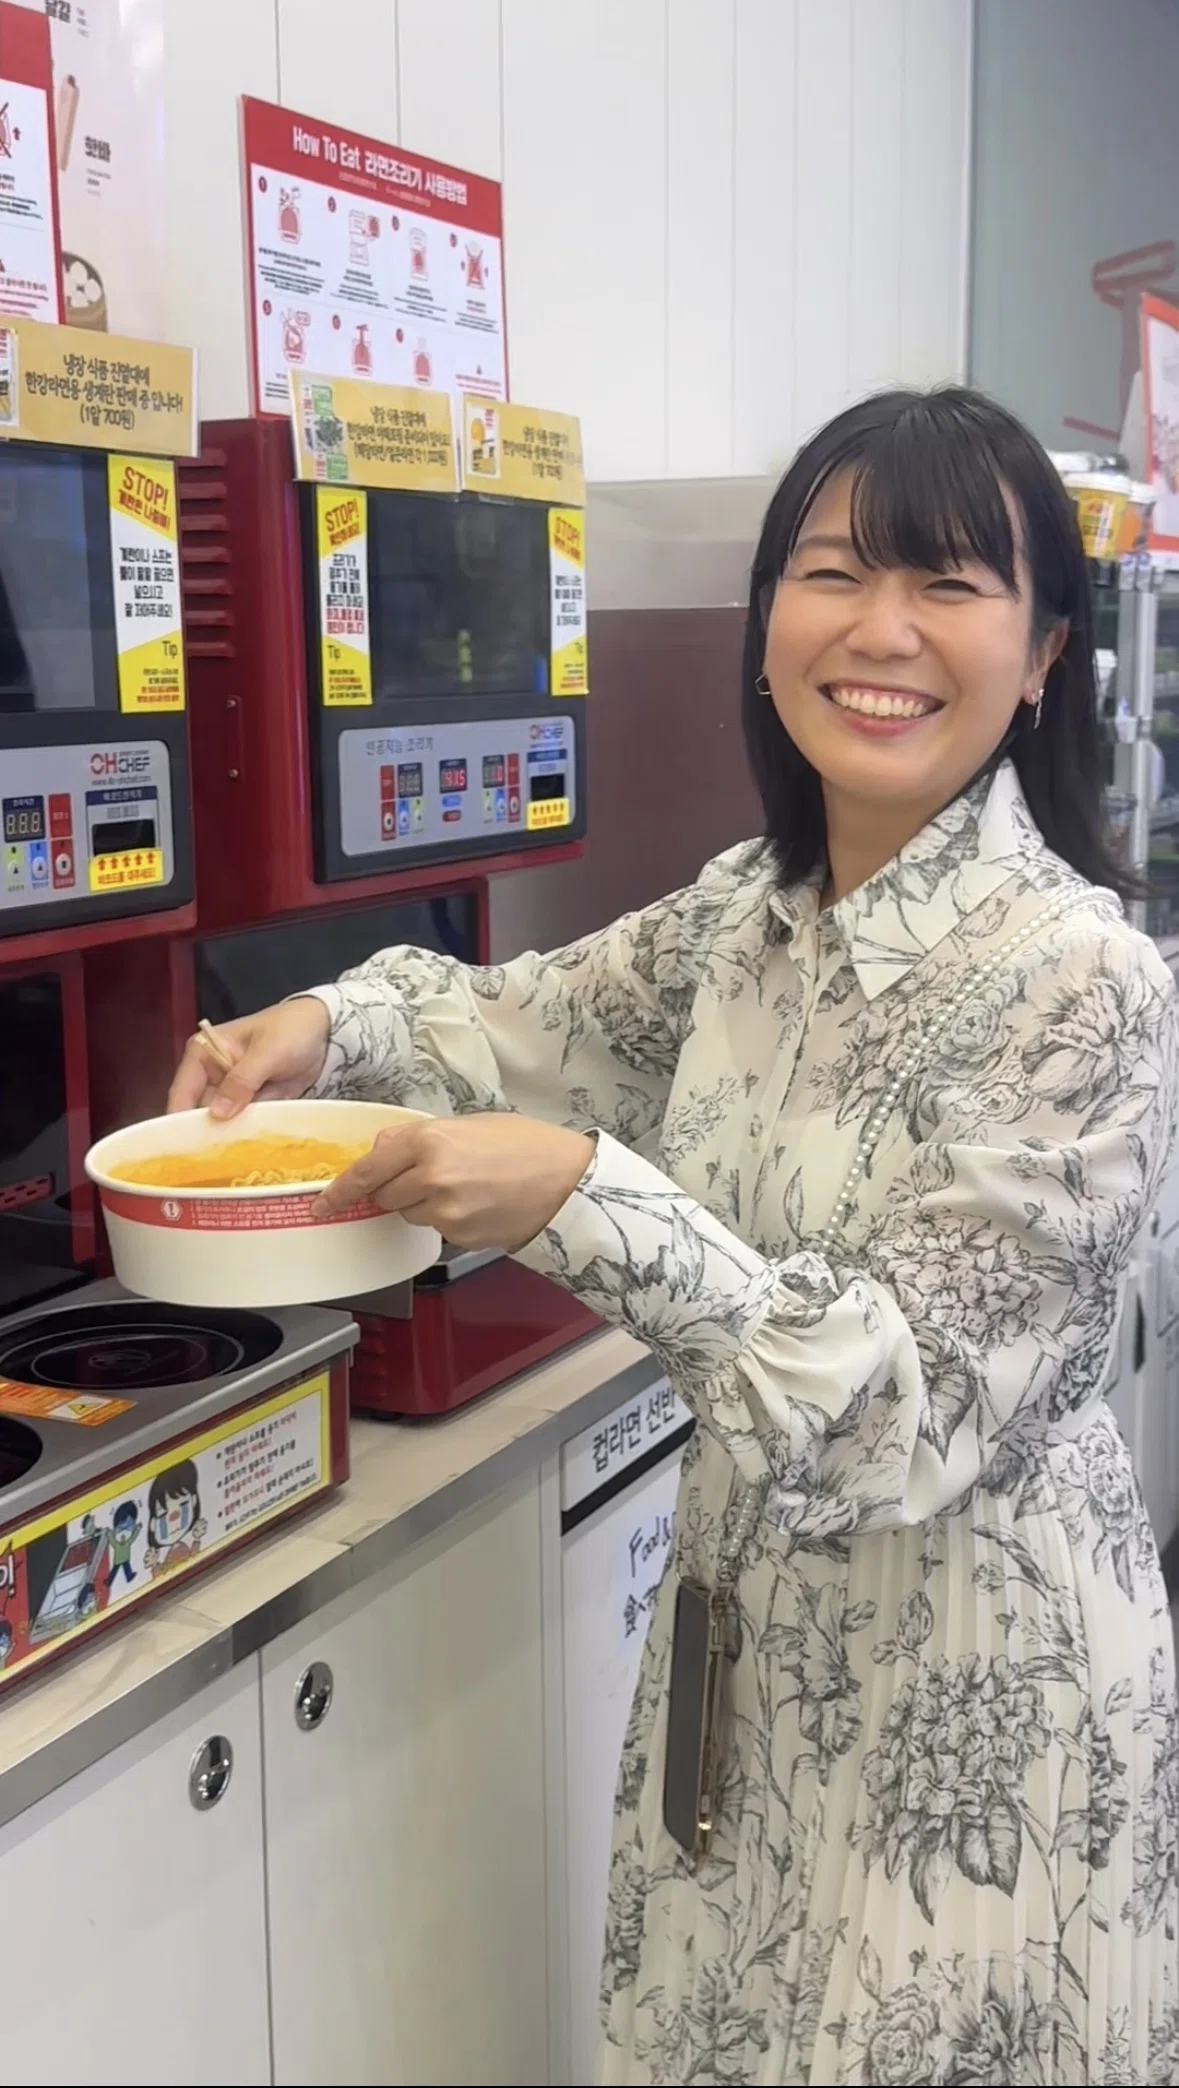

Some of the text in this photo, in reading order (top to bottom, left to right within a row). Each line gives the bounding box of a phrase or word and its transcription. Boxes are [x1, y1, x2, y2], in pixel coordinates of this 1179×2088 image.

[292, 126, 321, 157] How
[322, 136, 338, 163] To
[339, 142, 362, 171] Eat
[364, 150, 424, 191] 라면조리기
[424, 171, 468, 206] 사용방법
[63, 354, 150, 386] 냉장 식품 진열대에
[25, 371, 82, 401] 한강라면용
[115, 386, 137, 407] 판매
[122, 466, 168, 511] STOP!
[325, 498, 359, 532] STOP!
[119, 547, 173, 564] 계란이나 스프는
[134, 585, 165, 599] 넣으시고
[161, 640, 177, 660] Tip
[327, 645, 342, 664] Tip
[119, 757, 151, 773] CHEF
[593, 1405, 641, 1472] 컵라면
